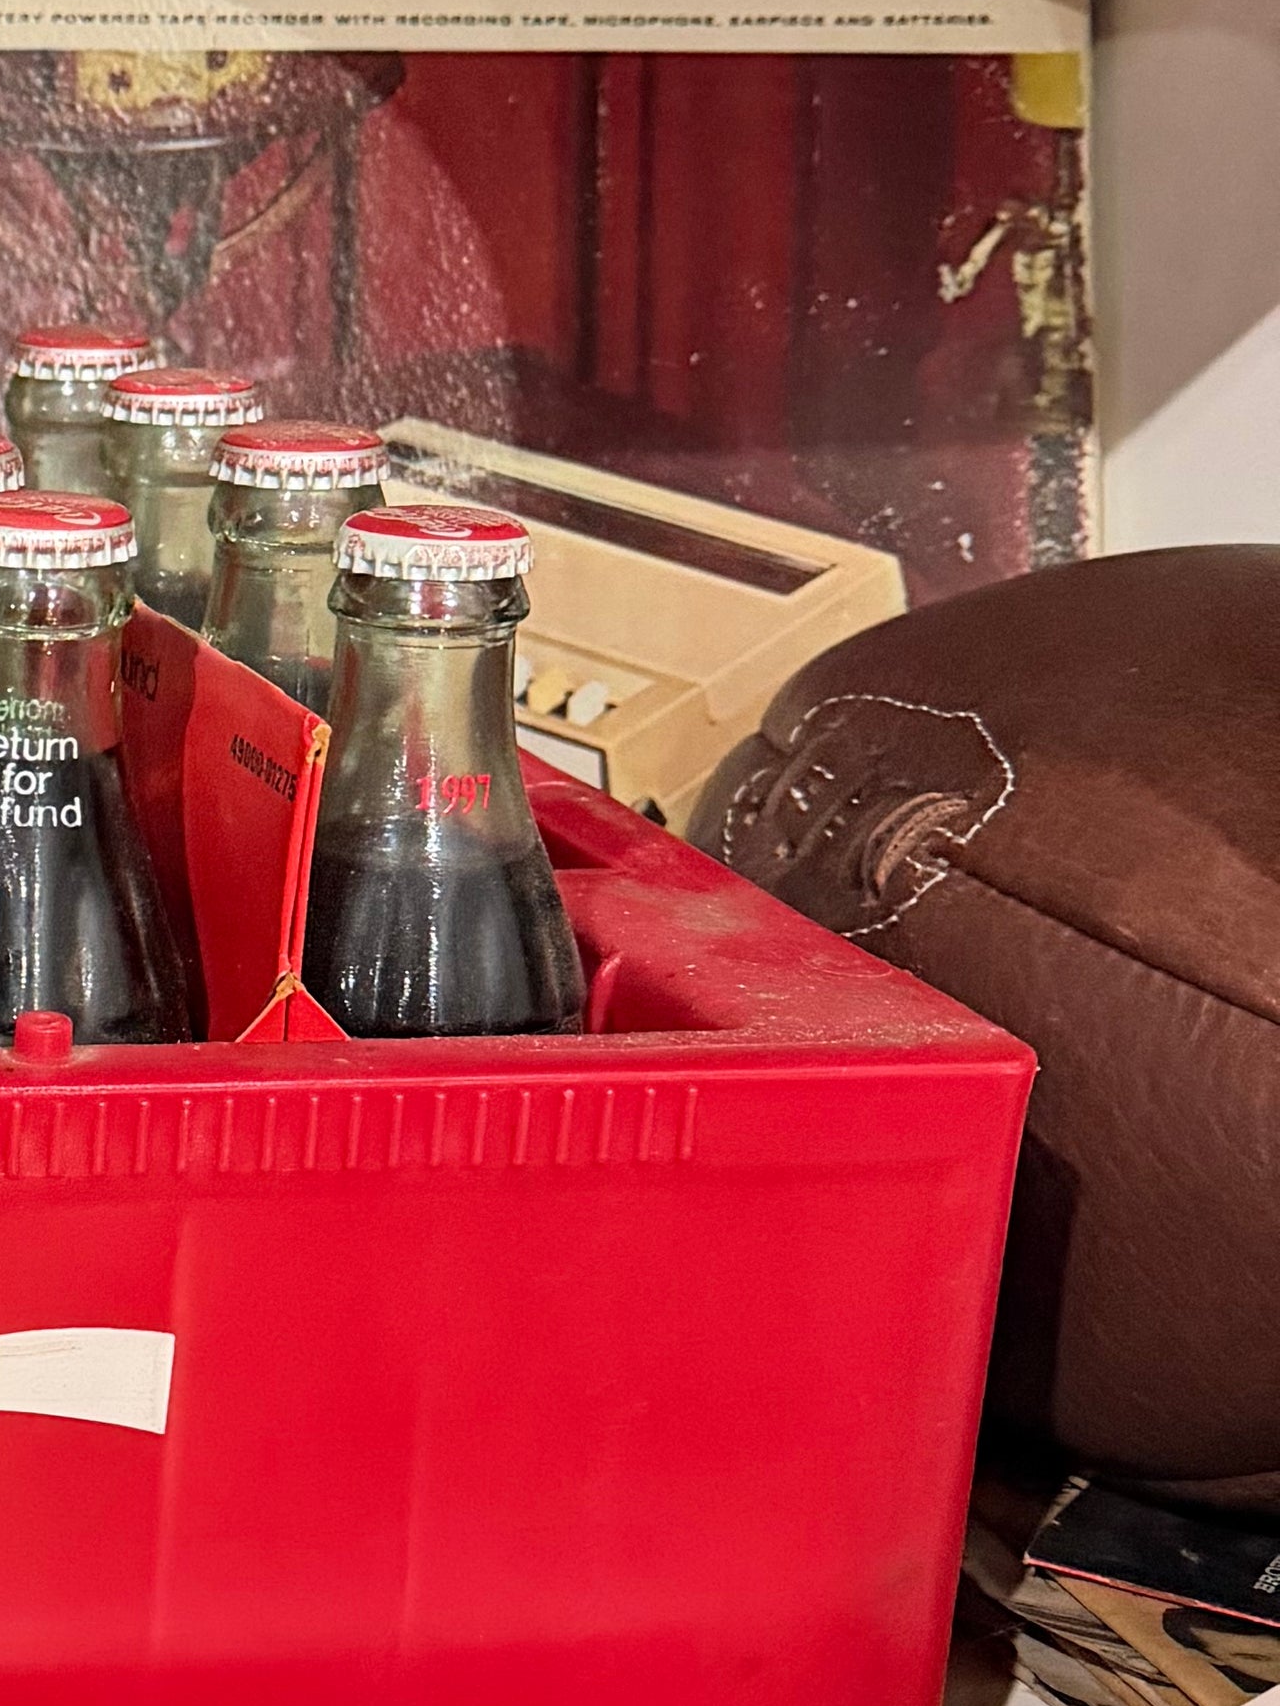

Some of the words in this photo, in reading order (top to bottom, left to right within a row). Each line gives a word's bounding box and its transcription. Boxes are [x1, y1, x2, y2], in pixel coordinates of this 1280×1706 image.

[50, 11, 151, 26] POWERED
[159, 12, 208, 27] TAPE
[334, 13, 386, 27] WITH
[394, 13, 513, 28] RECORDING
[1, 762, 53, 795] for
[414, 773, 491, 814] 1997
